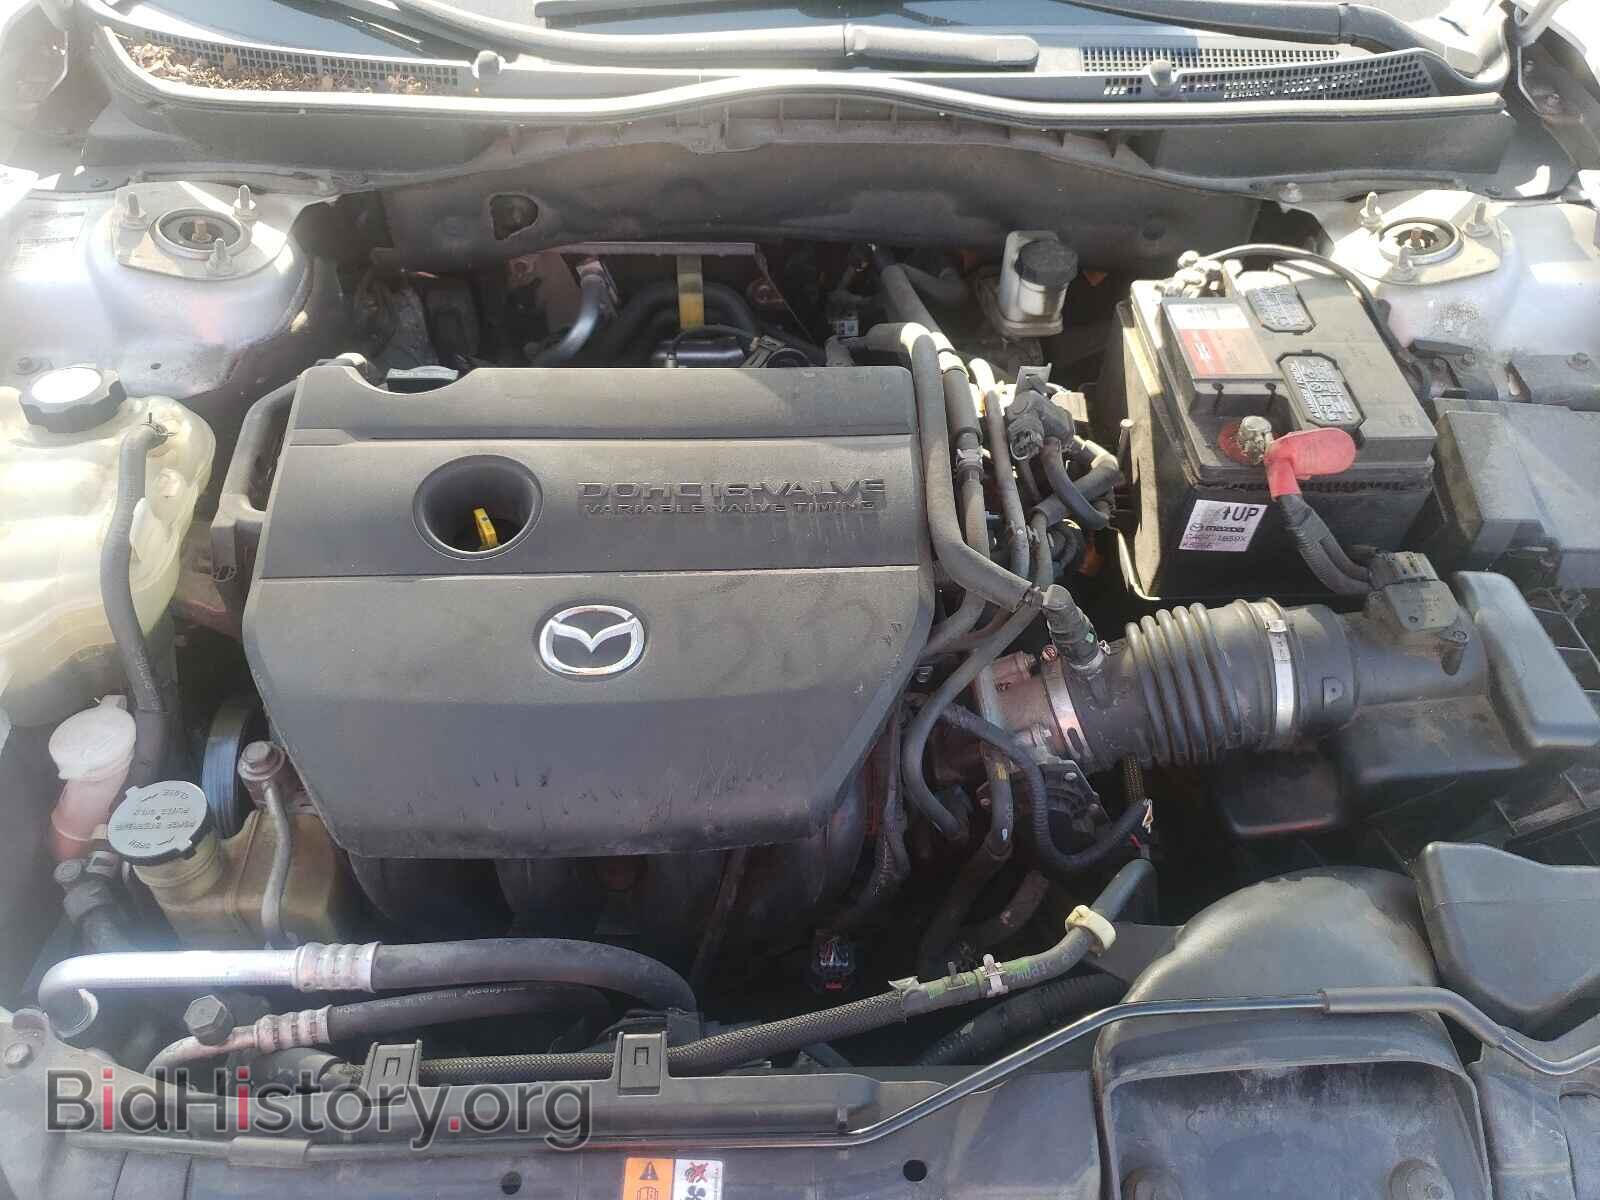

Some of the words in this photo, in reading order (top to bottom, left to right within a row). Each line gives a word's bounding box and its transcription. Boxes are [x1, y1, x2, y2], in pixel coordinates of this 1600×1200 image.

[576, 481, 702, 498] DOHC
[583, 503, 705, 513] VARIABLE
[716, 502, 786, 513] VALVE
[793, 500, 874, 513] TIMING
[1231, 506, 1259, 521] UP
